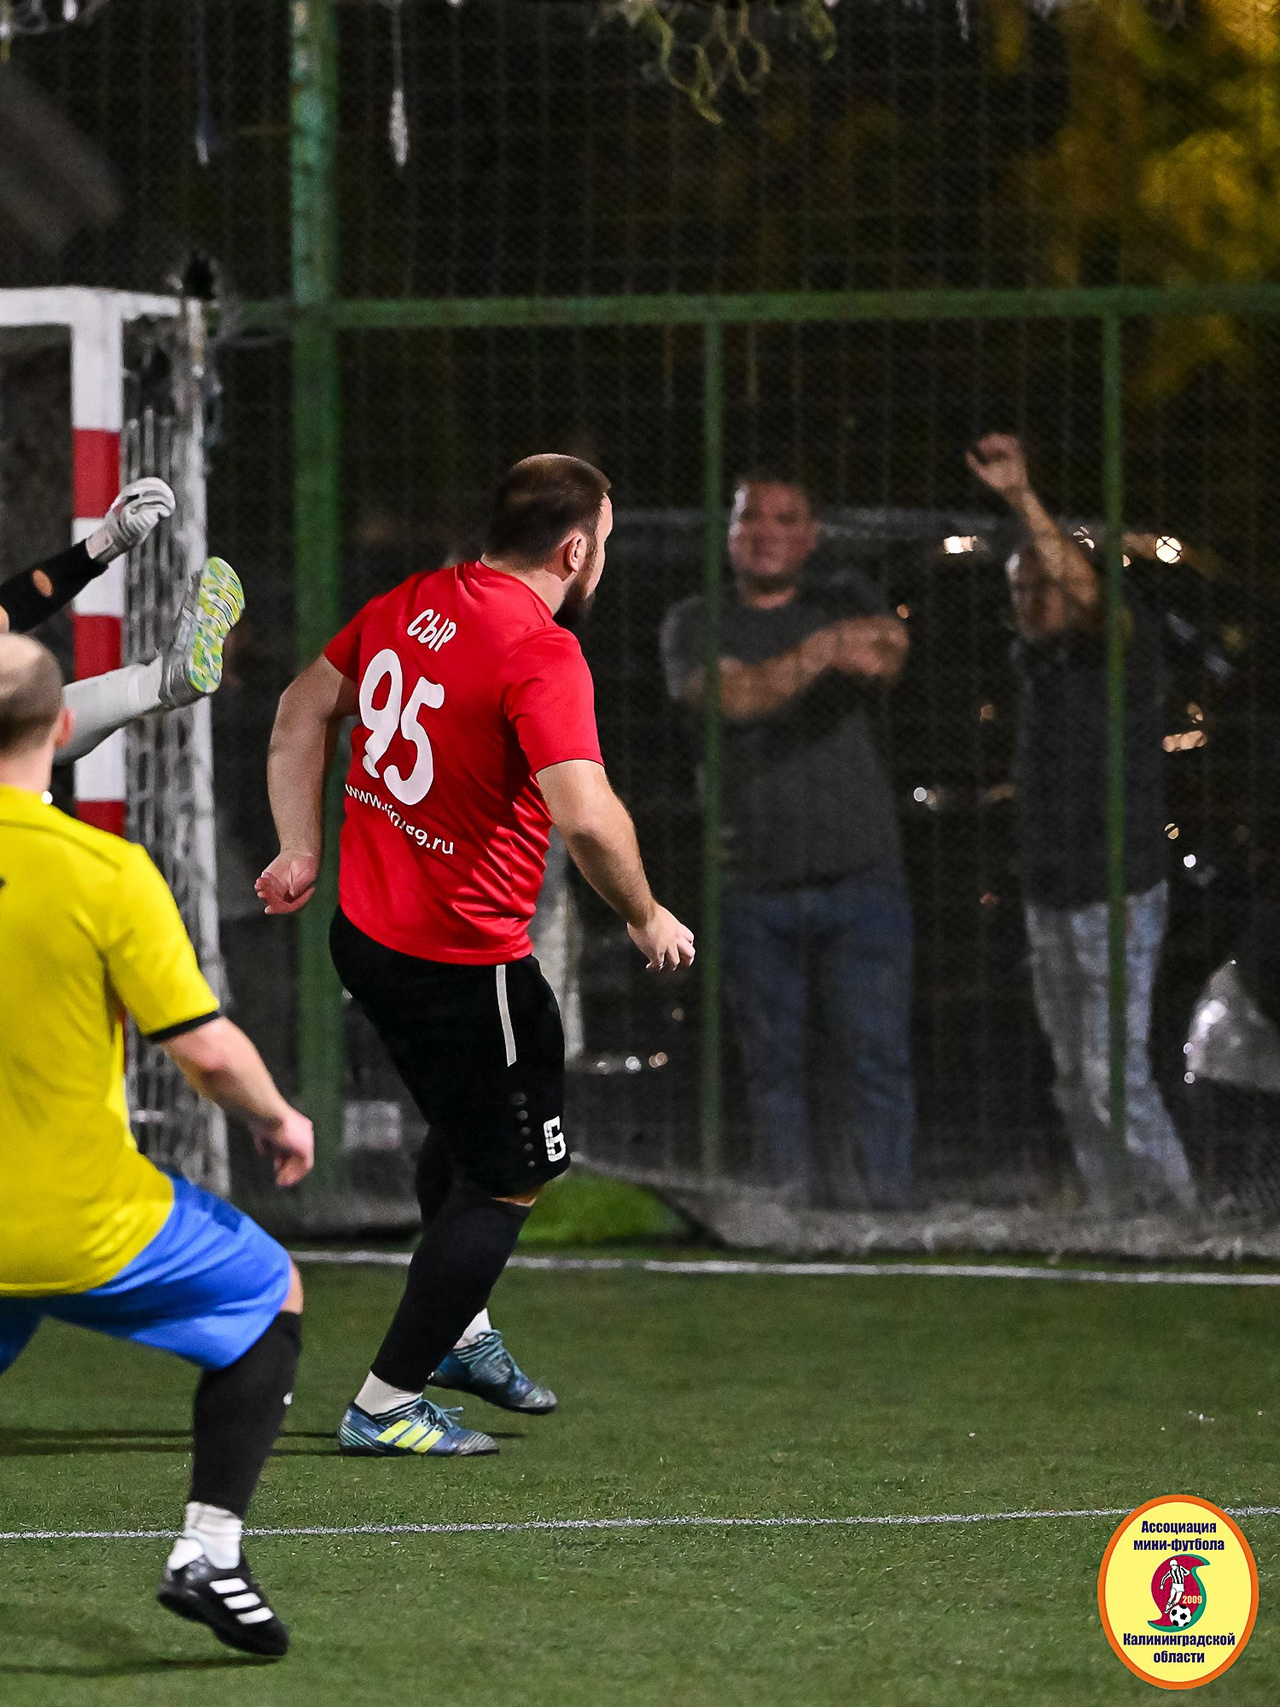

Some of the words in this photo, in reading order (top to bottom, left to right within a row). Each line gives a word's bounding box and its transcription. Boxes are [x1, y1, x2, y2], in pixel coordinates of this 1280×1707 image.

[406, 608, 457, 652] СЫР
[358, 648, 445, 806] 95
[543, 1115, 567, 1163] 6
